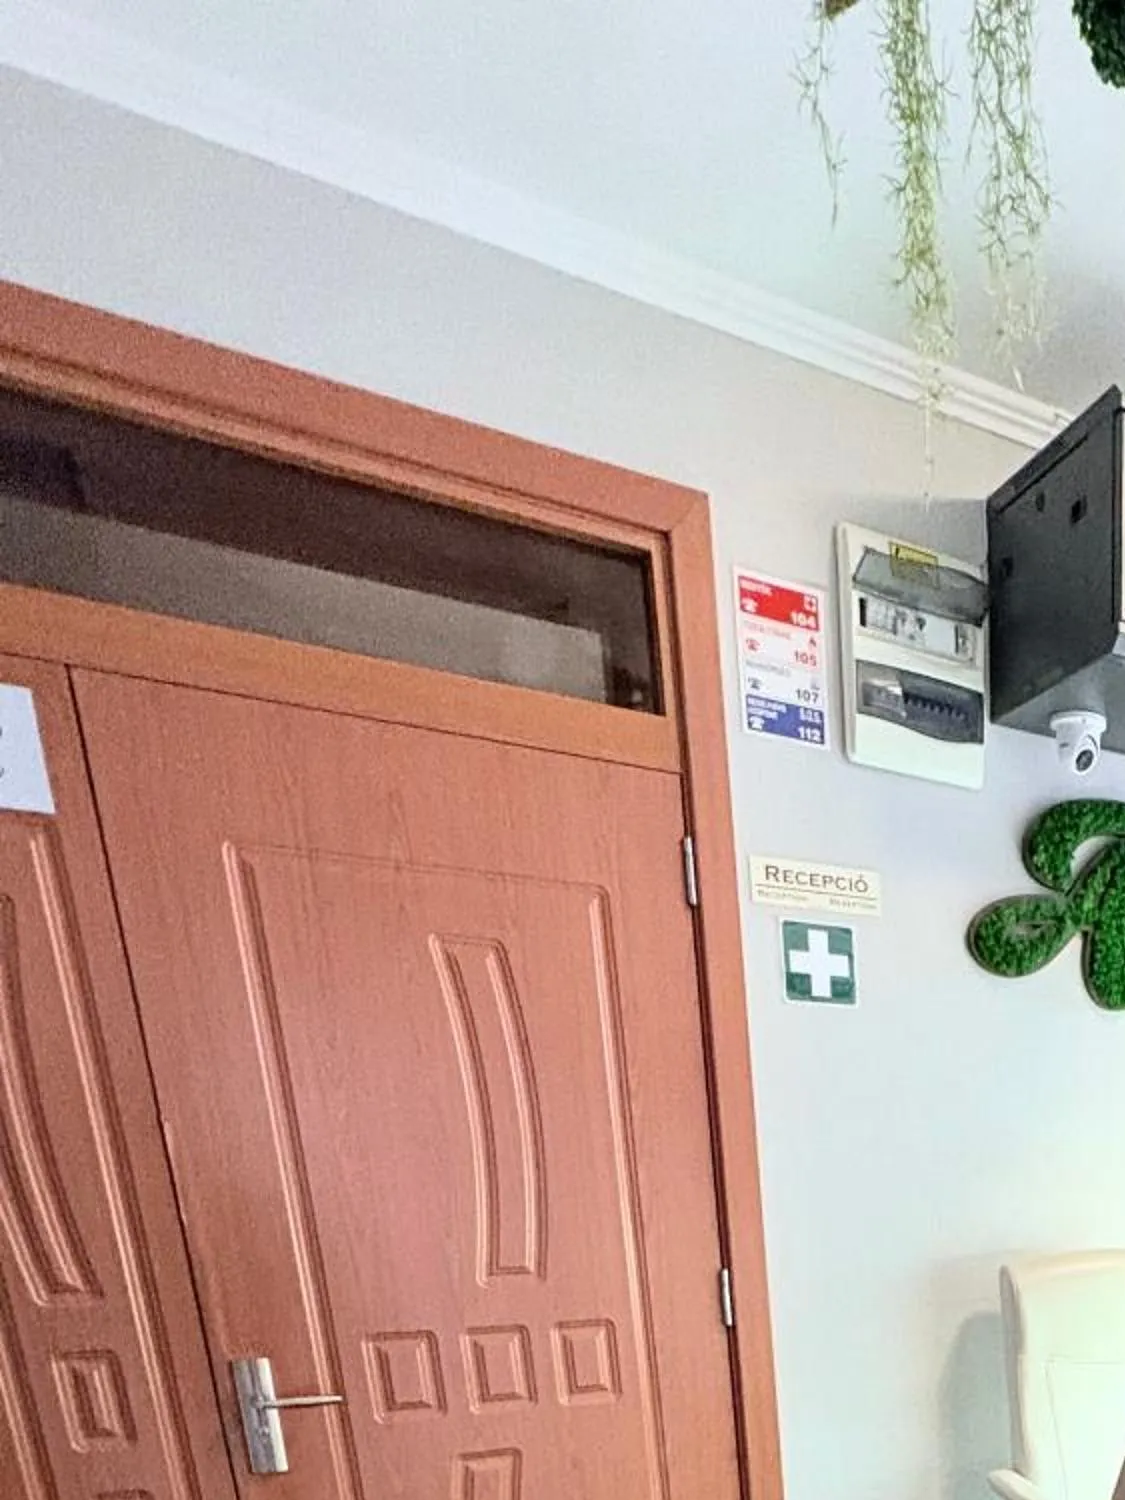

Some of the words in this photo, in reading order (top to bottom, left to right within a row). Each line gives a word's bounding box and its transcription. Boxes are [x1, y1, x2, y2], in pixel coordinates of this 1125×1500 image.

[789, 611, 817, 629] 104
[794, 650, 818, 667] 105
[796, 688, 819, 704] 107
[798, 726, 822, 743] 112
[764, 863, 869, 893] RECEPCIÓ
